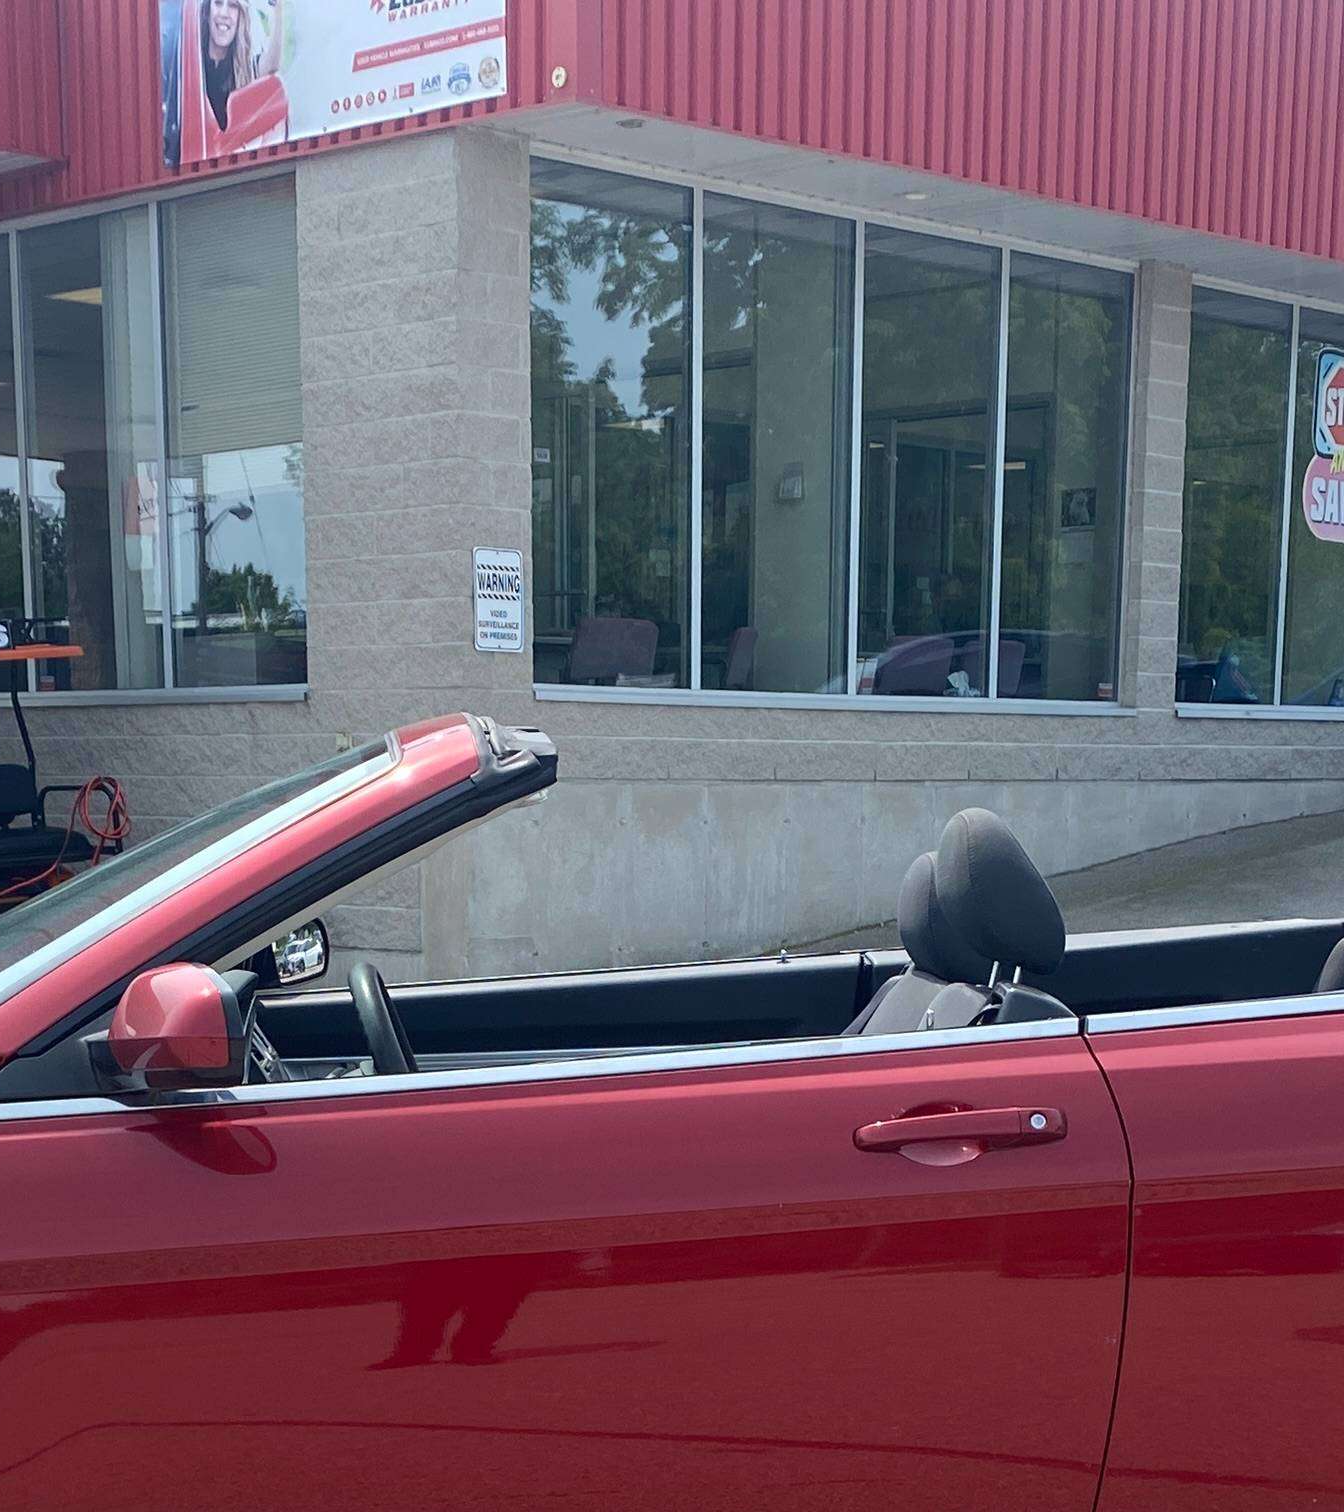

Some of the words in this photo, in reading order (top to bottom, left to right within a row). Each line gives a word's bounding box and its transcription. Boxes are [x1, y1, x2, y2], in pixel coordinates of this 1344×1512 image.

[477, 572, 520, 594] WARNING
[490, 609, 508, 618] VIDEO
[478, 620, 519, 630] SURVEILLANCE
[480, 631, 489, 639] ON
